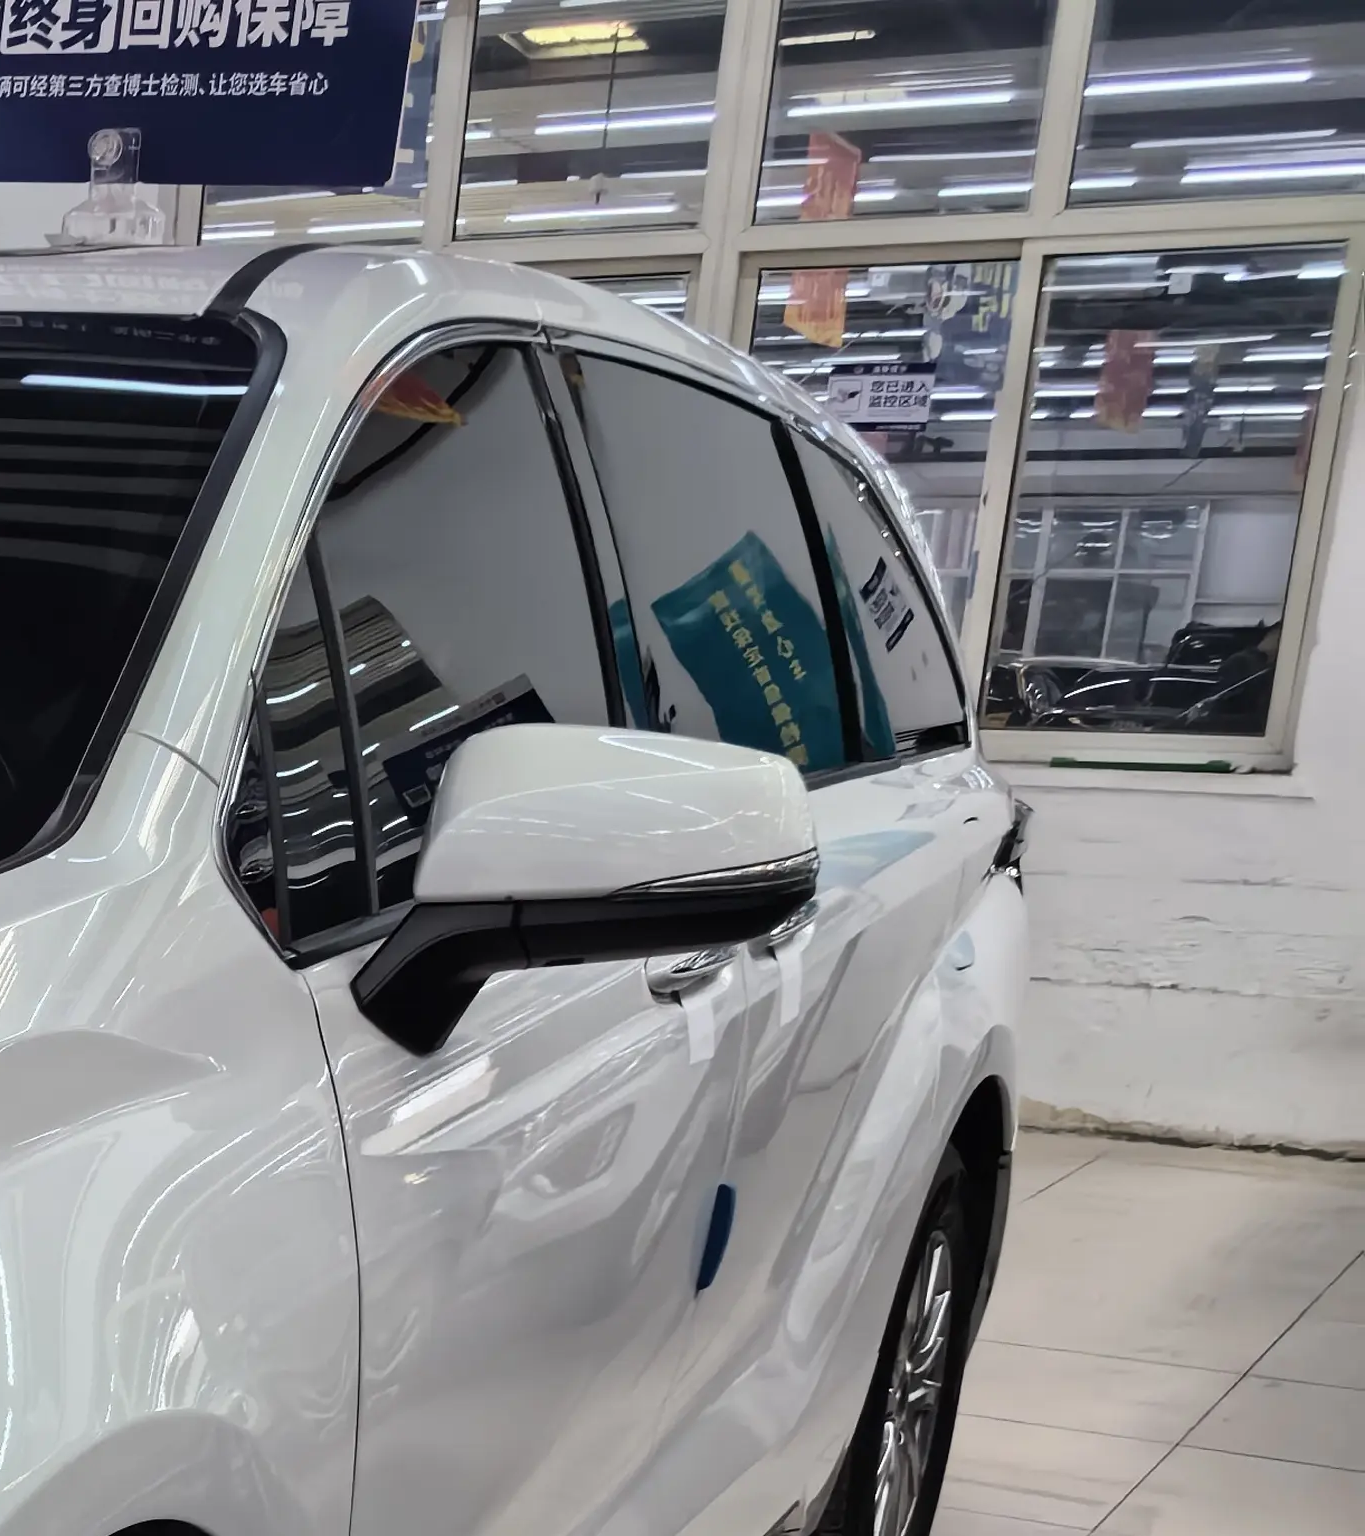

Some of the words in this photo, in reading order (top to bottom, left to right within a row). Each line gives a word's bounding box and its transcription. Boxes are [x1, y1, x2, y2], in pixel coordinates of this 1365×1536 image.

[5, 0, 351, 50] 终身回购保障
